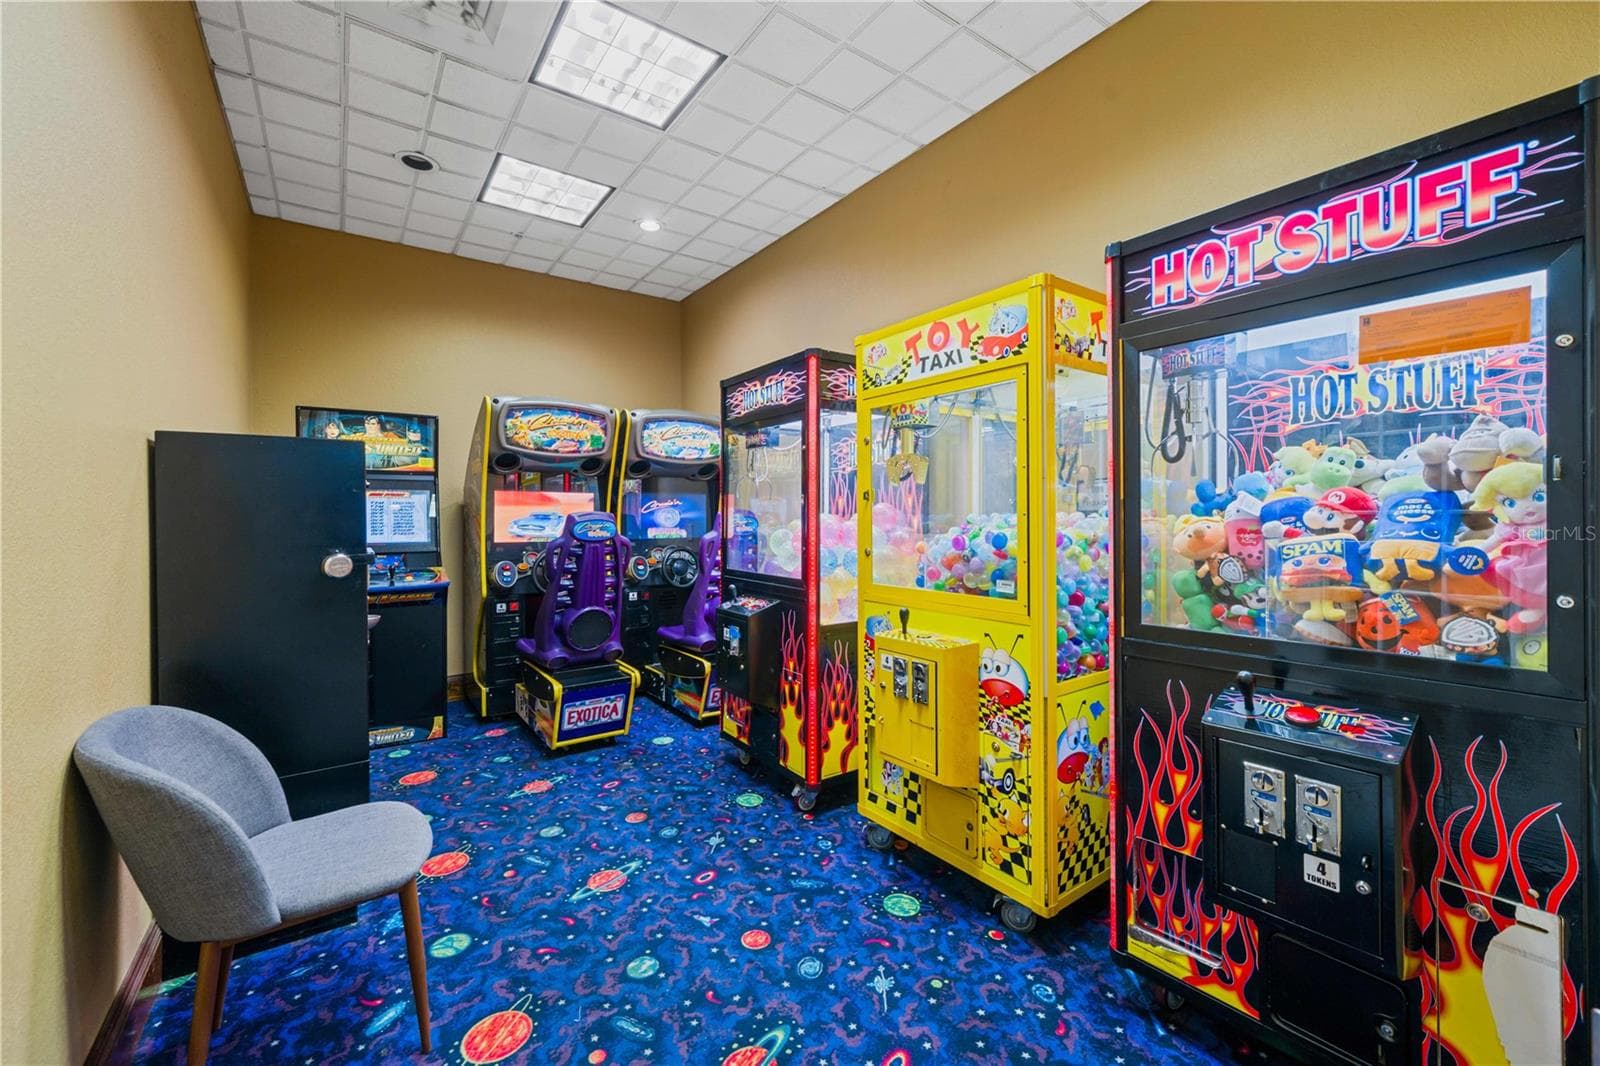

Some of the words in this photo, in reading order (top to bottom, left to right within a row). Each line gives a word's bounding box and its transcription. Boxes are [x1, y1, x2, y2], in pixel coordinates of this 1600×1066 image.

[1150, 224, 1264, 308] HOT
[1272, 142, 1526, 276] STUFF
[903, 317, 980, 366] TOY
[919, 348, 964, 374] TAXI
[1288, 372, 1358, 425] HOT
[1366, 348, 1488, 415] STUFF
[1282, 539, 1342, 560] SPAM
[1391, 591, 1418, 618] SPAM
[567, 703, 619, 726] EXOTICA
[1306, 873, 1337, 890] TOKENS
[1316, 862, 1327, 876] 4
